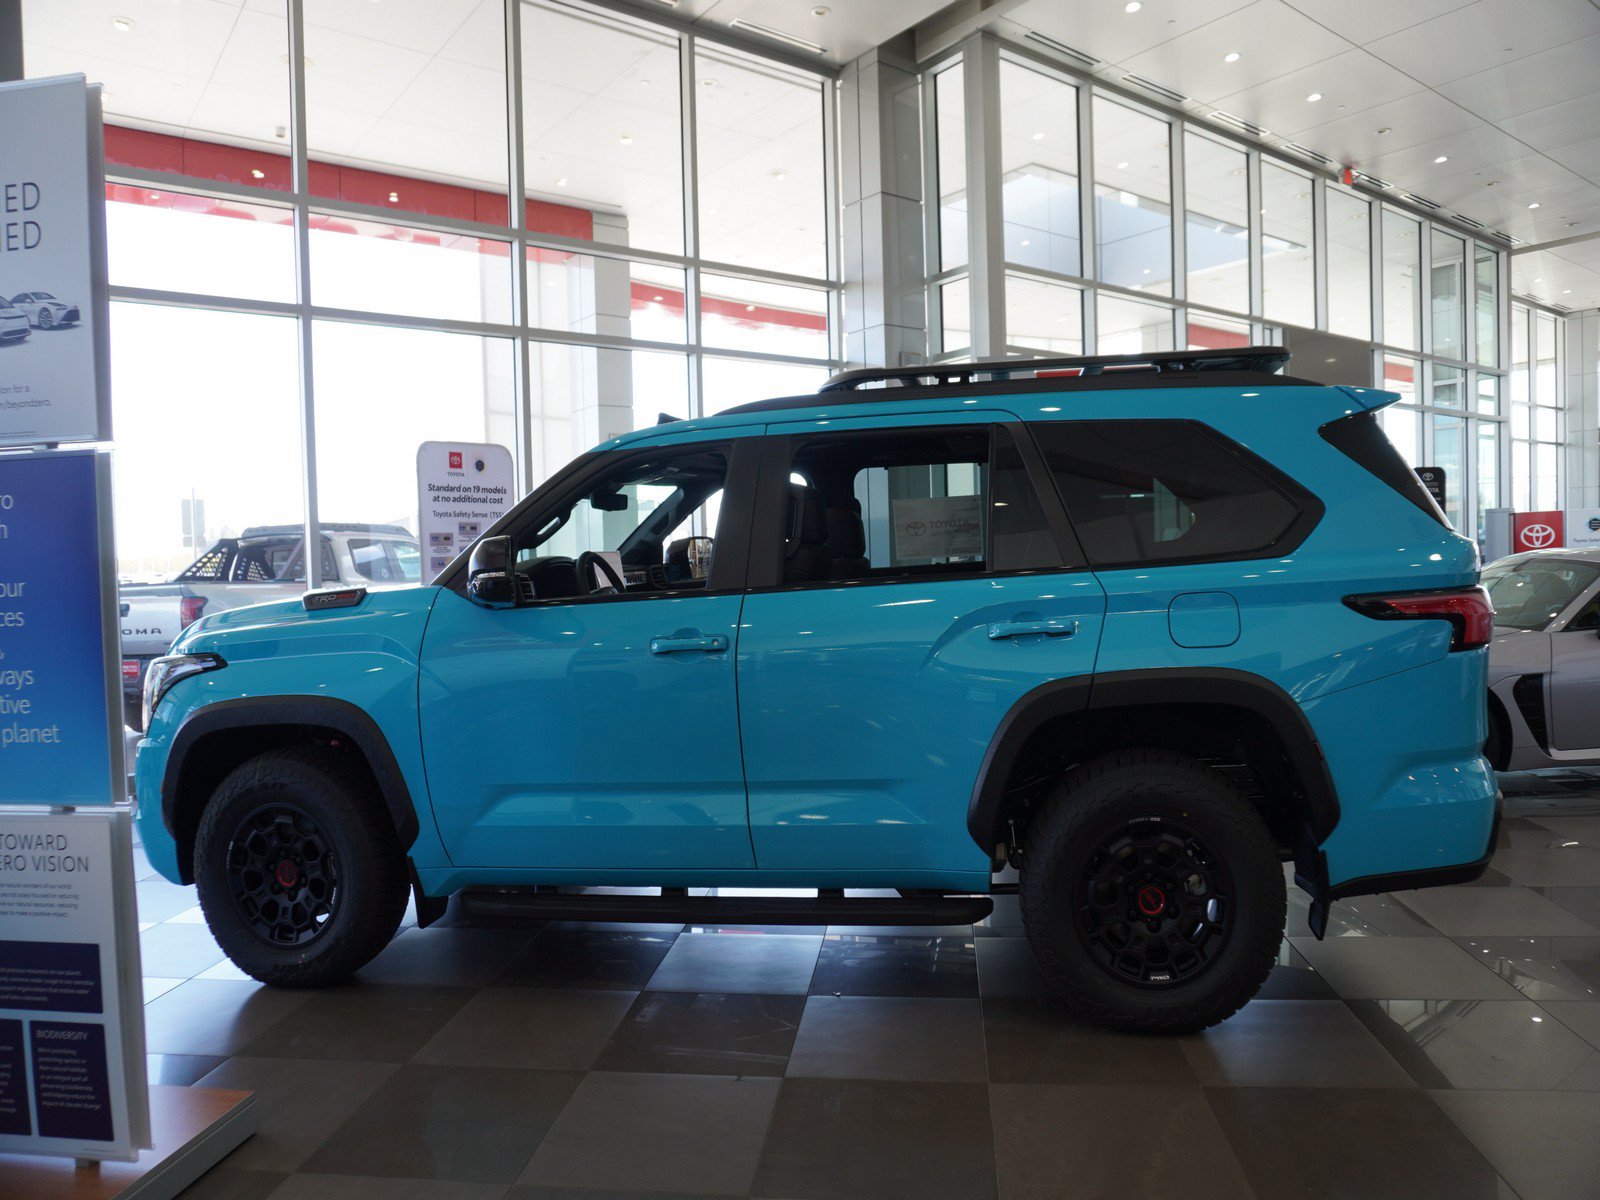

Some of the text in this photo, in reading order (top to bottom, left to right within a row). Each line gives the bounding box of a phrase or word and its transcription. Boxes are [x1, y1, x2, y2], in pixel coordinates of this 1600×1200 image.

[427, 483, 461, 493] Standard
[473, 485, 480, 493] 19
[481, 486, 507, 494] models
[452, 494, 488, 504] additional
[433, 510, 452, 519] Toyota
[453, 511, 471, 519] Safety
[928, 518, 969, 529] TOYOTA
[2, 722, 61, 748] planet
[31, 855, 89, 872] VISION
[36, 1029, 89, 1041] BIODIVERSITY
